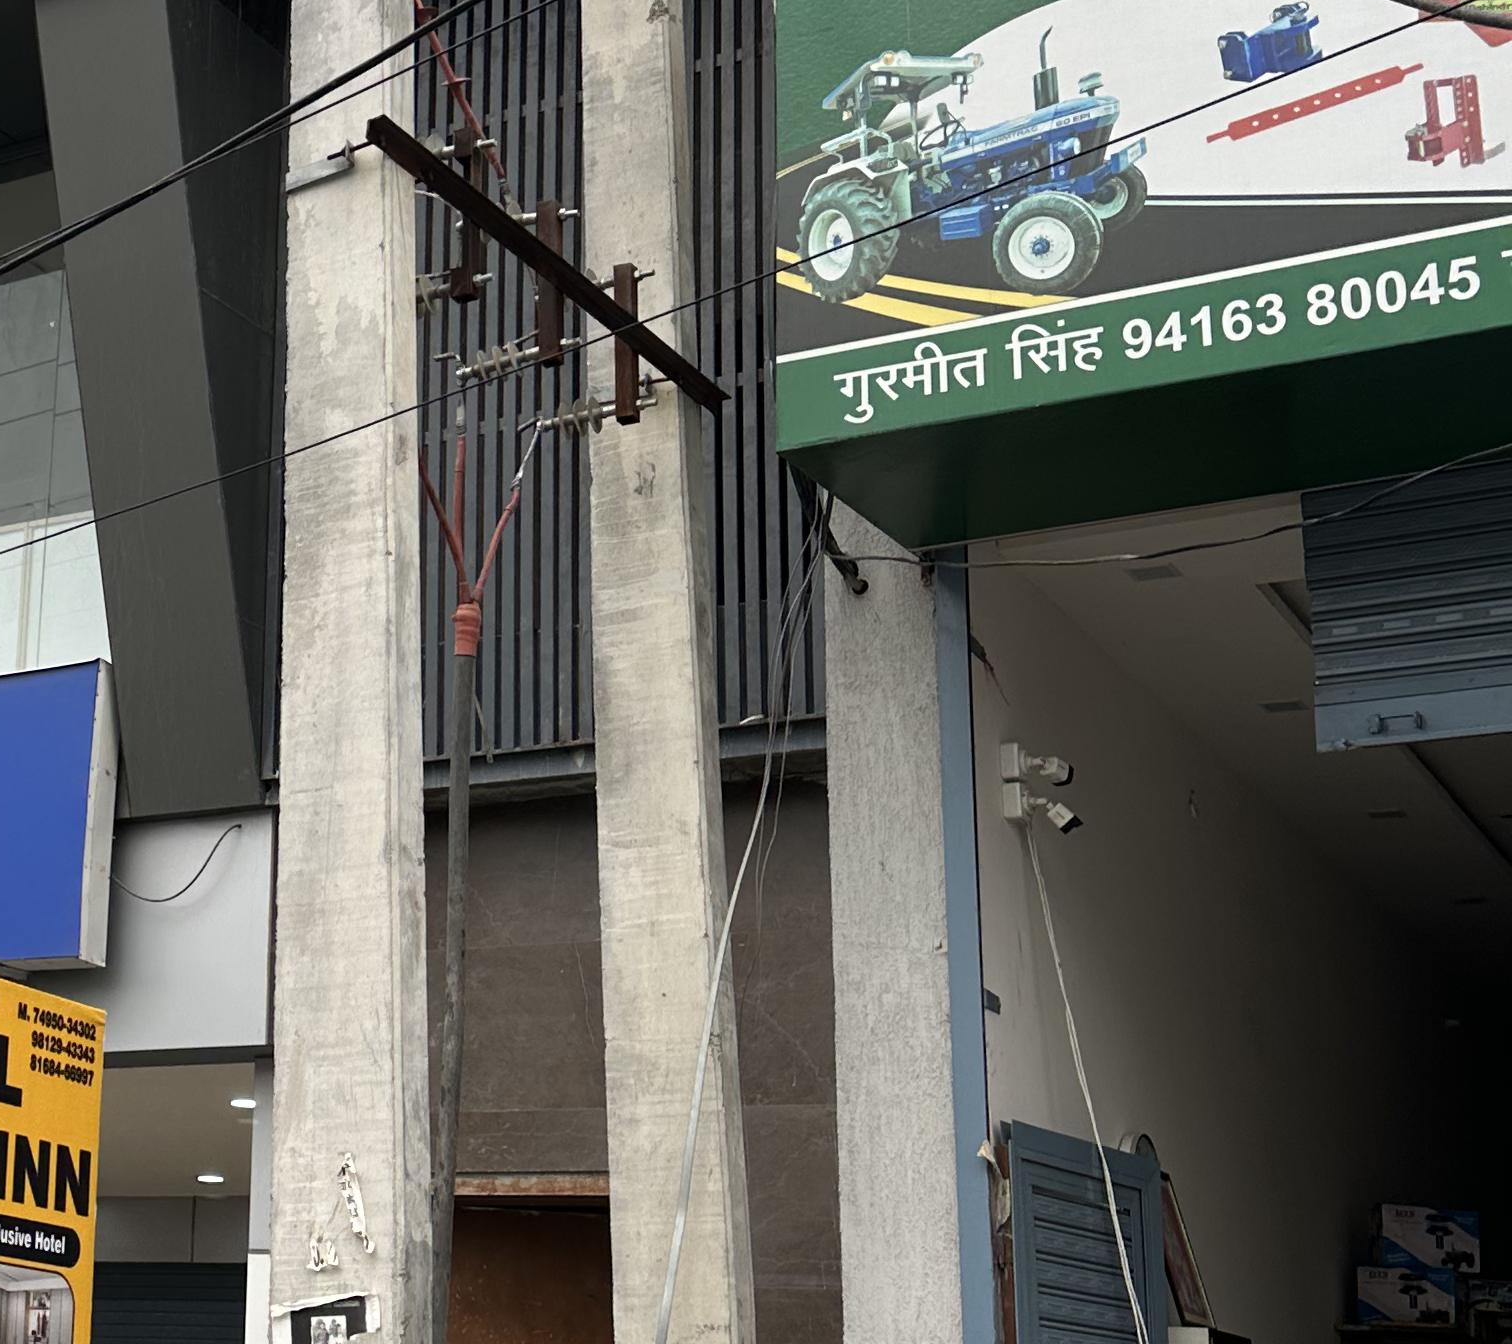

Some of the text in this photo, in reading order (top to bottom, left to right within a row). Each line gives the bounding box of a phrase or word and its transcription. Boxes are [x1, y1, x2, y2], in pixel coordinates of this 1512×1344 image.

[832, 341, 988, 425] गुरमीत
[1004, 321, 1105, 381] सिंह
[1121, 293, 1288, 360] 94163
[1305, 256, 1482, 327] 80045
[17, 1001, 30, 1022] M.
[34, 1229, 66, 1256] Hotel
